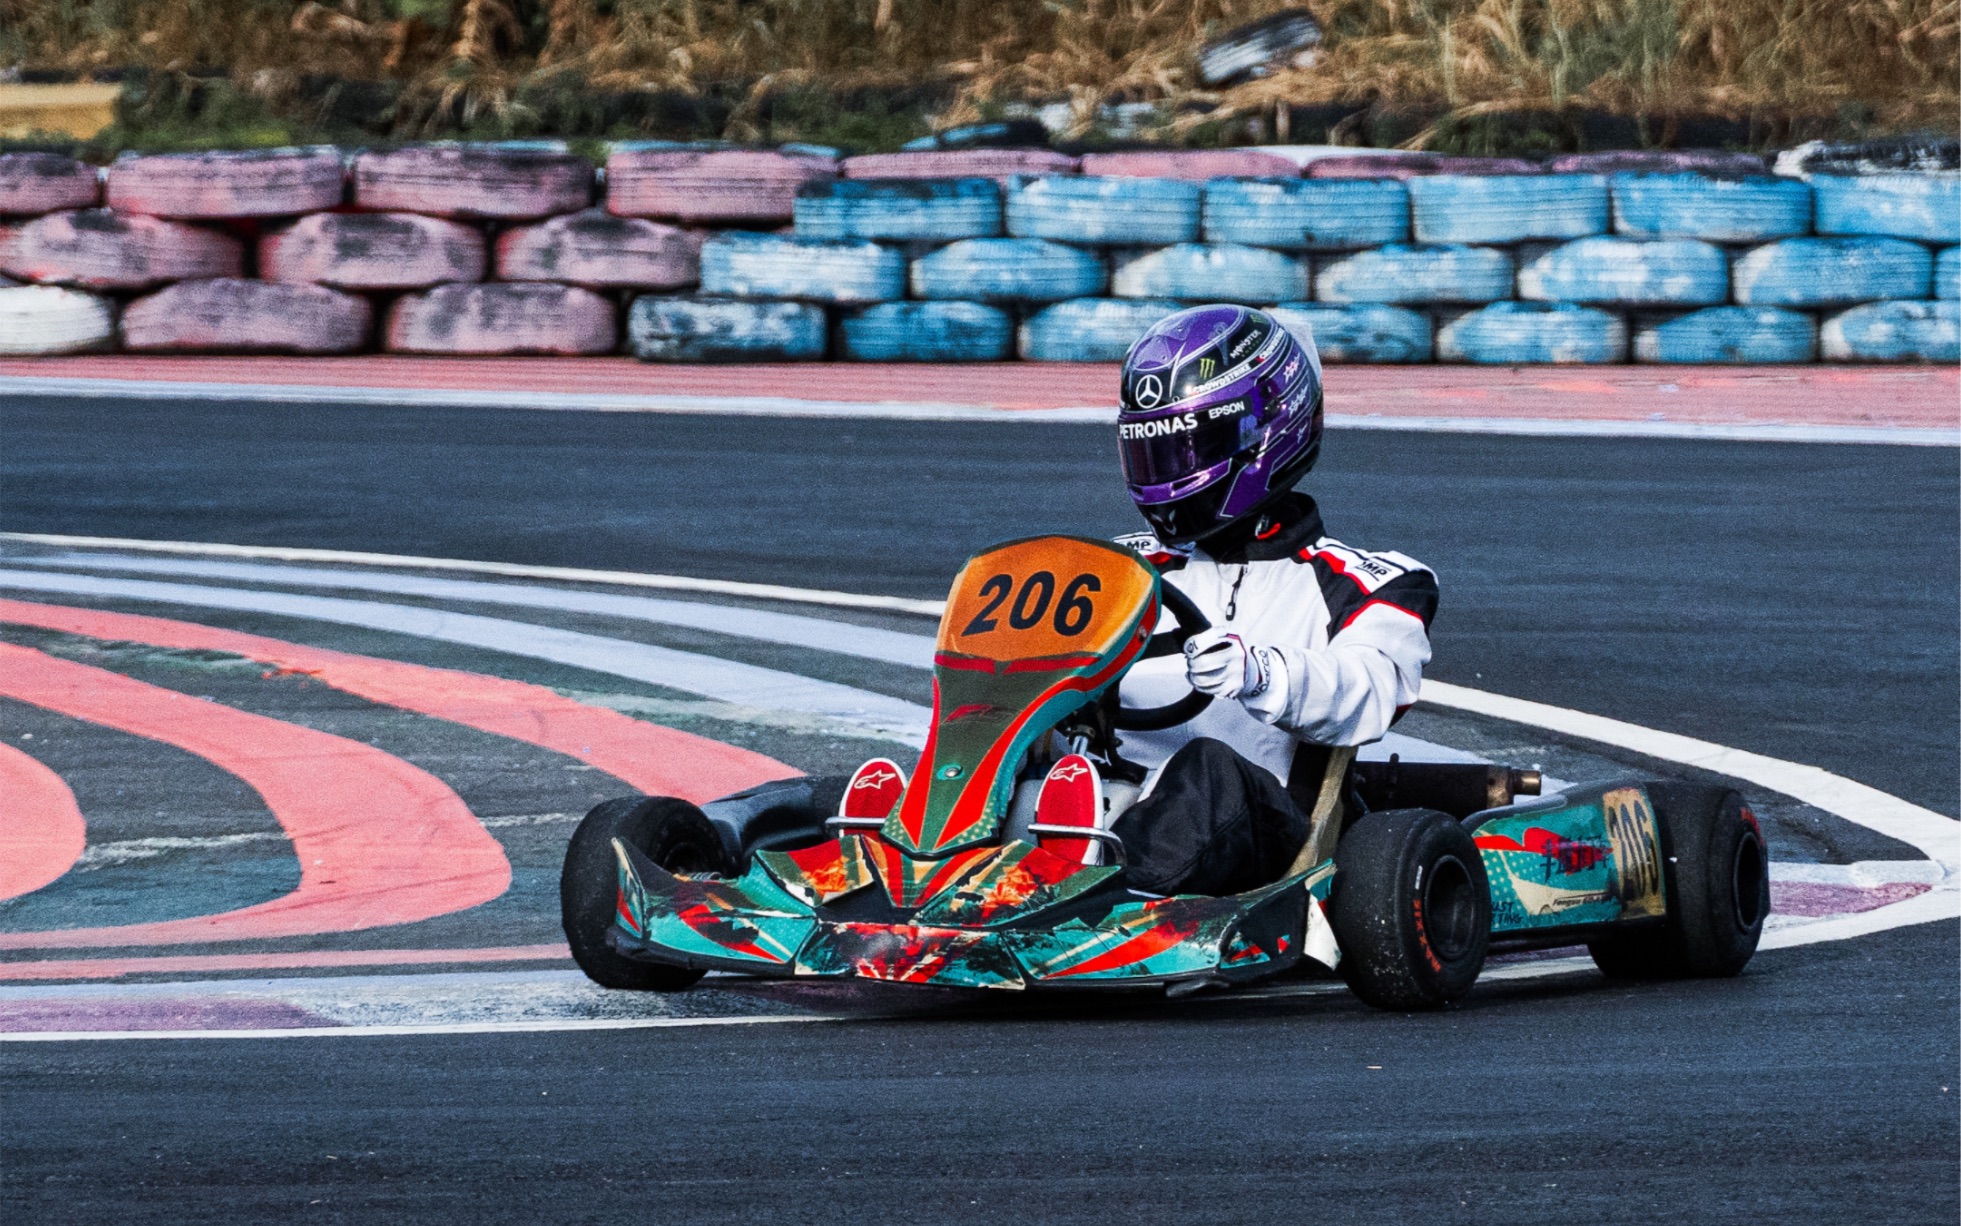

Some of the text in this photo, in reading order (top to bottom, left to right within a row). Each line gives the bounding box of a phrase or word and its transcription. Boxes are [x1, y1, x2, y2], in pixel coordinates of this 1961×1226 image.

[1208, 400, 1245, 419] EPSON
[1125, 540, 1151, 550] MP
[960, 570, 1102, 637] 206
